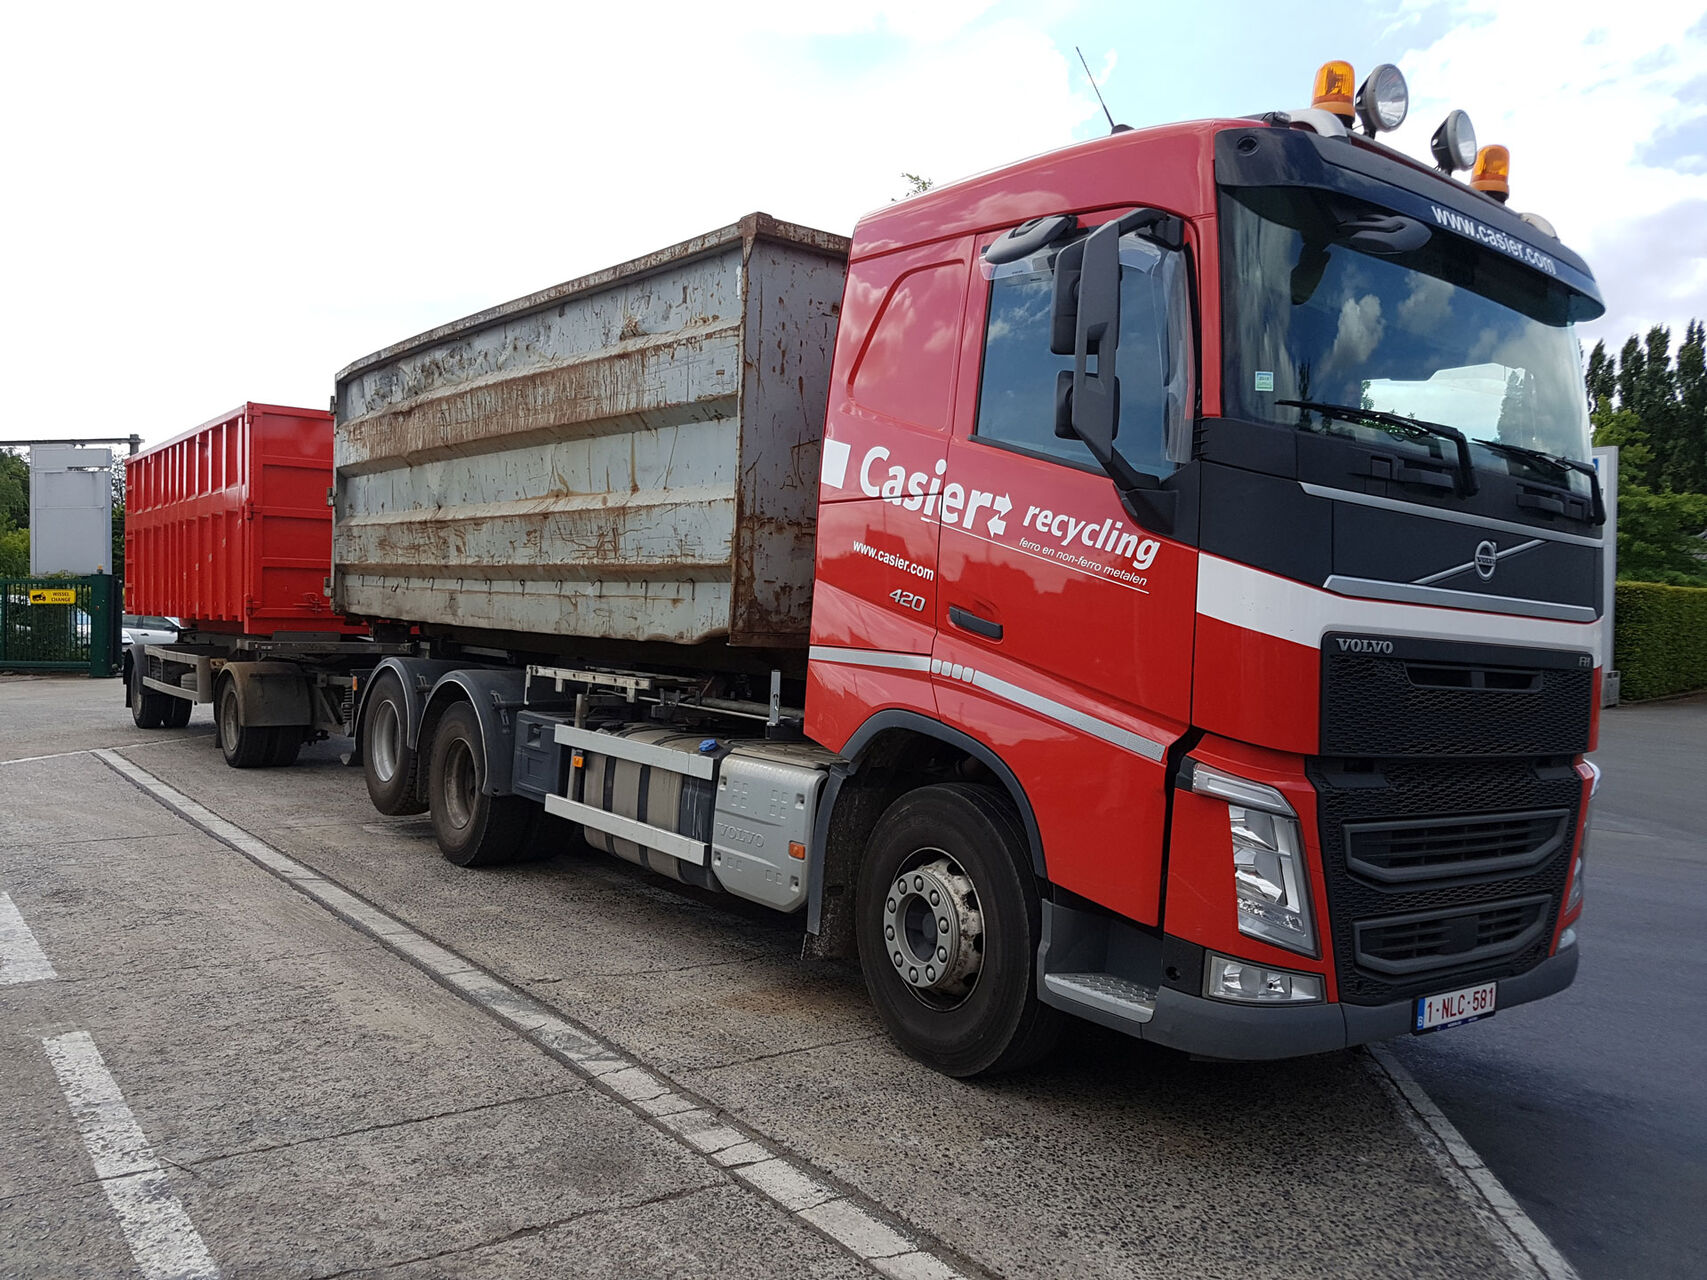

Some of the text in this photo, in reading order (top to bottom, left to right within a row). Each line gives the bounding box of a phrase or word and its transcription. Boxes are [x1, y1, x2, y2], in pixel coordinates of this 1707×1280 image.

[1431, 205, 1557, 275] www.casier.com
[859, 446, 993, 530] Casier
[1022, 505, 1160, 570] recycling
[853, 540, 934, 581] www.casier.com
[1019, 537, 1147, 586] ferro en non-ferro metalen
[889, 589, 926, 612] 420
[1336, 638, 1394, 654] VOLVO
[716, 822, 766, 848] VOLVO
